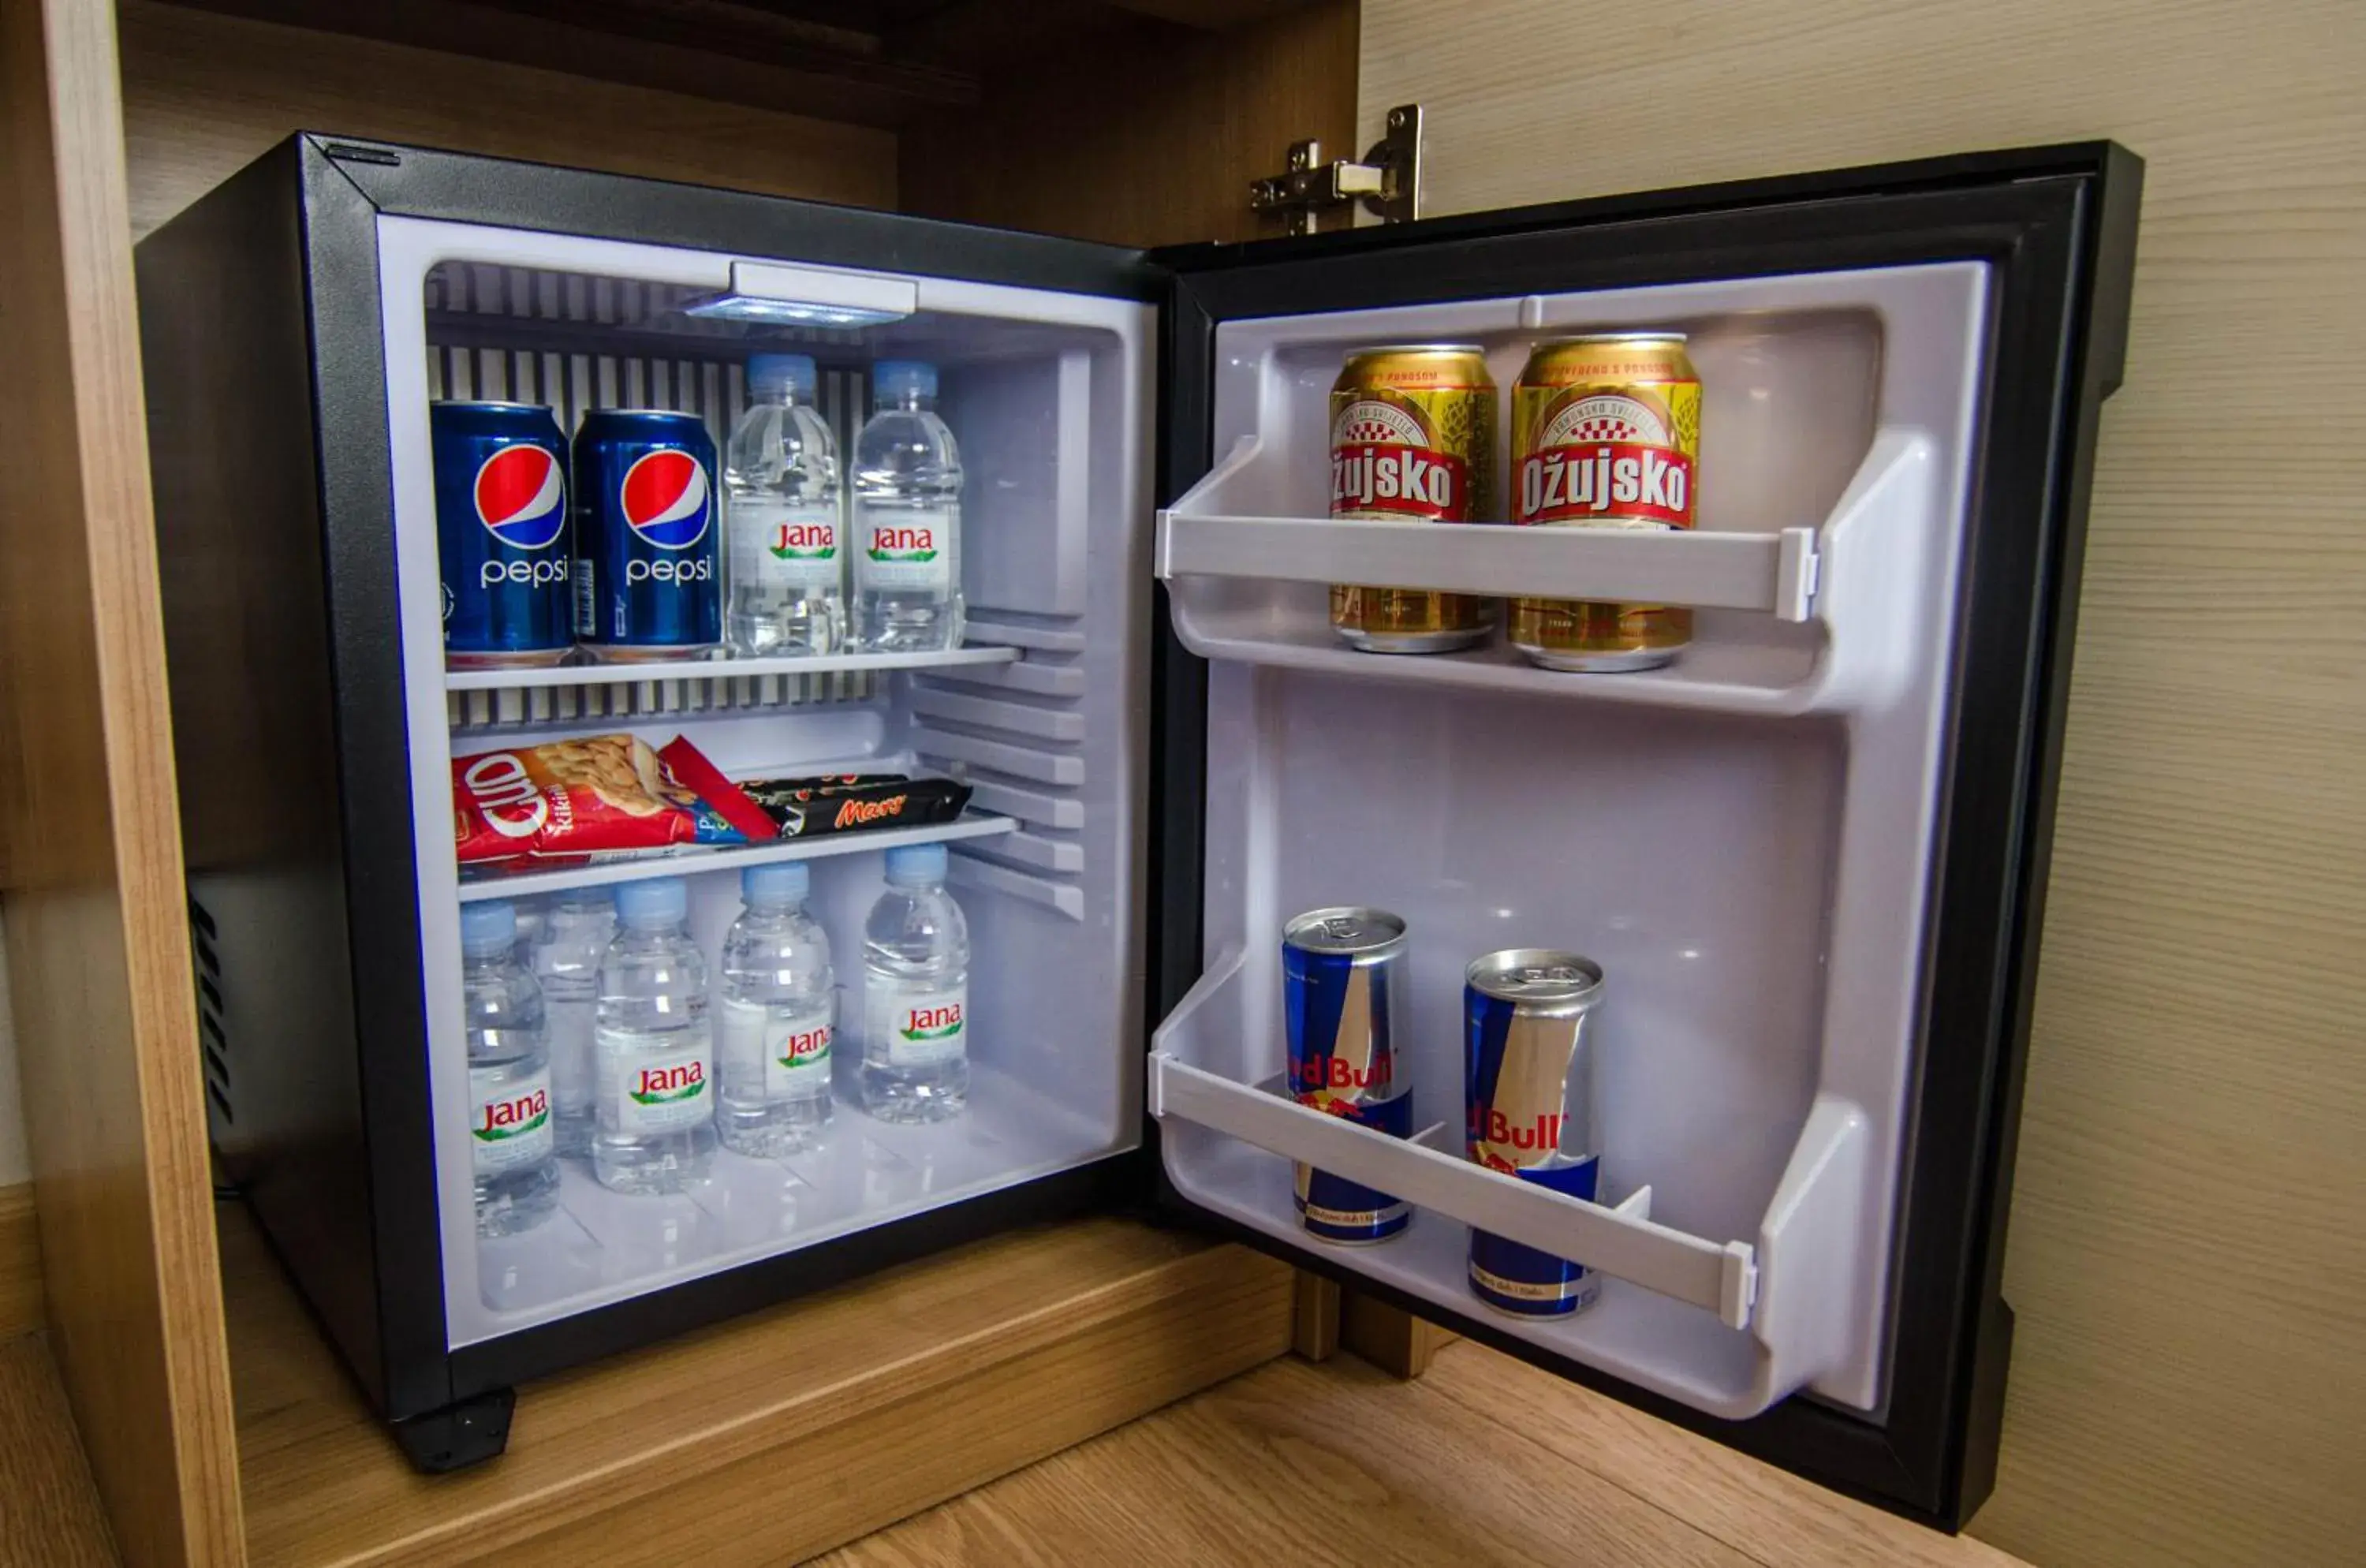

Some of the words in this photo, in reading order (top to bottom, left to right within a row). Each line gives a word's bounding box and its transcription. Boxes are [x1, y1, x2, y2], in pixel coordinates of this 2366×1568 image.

[1333, 448, 1451, 508] žujsko
[1522, 448, 1686, 517] Ožujsko
[778, 523, 834, 551] Jana
[873, 527, 932, 550] Jana
[481, 555, 569, 589] pepsi
[625, 555, 711, 588] pepsi
[834, 794, 907, 828] Mars
[909, 1003, 961, 1033] Jana
[787, 1025, 831, 1061] Jan
[638, 1061, 704, 1096] Jana
[482, 1089, 547, 1132] Jana
[1486, 1107, 1558, 1149] Bull
